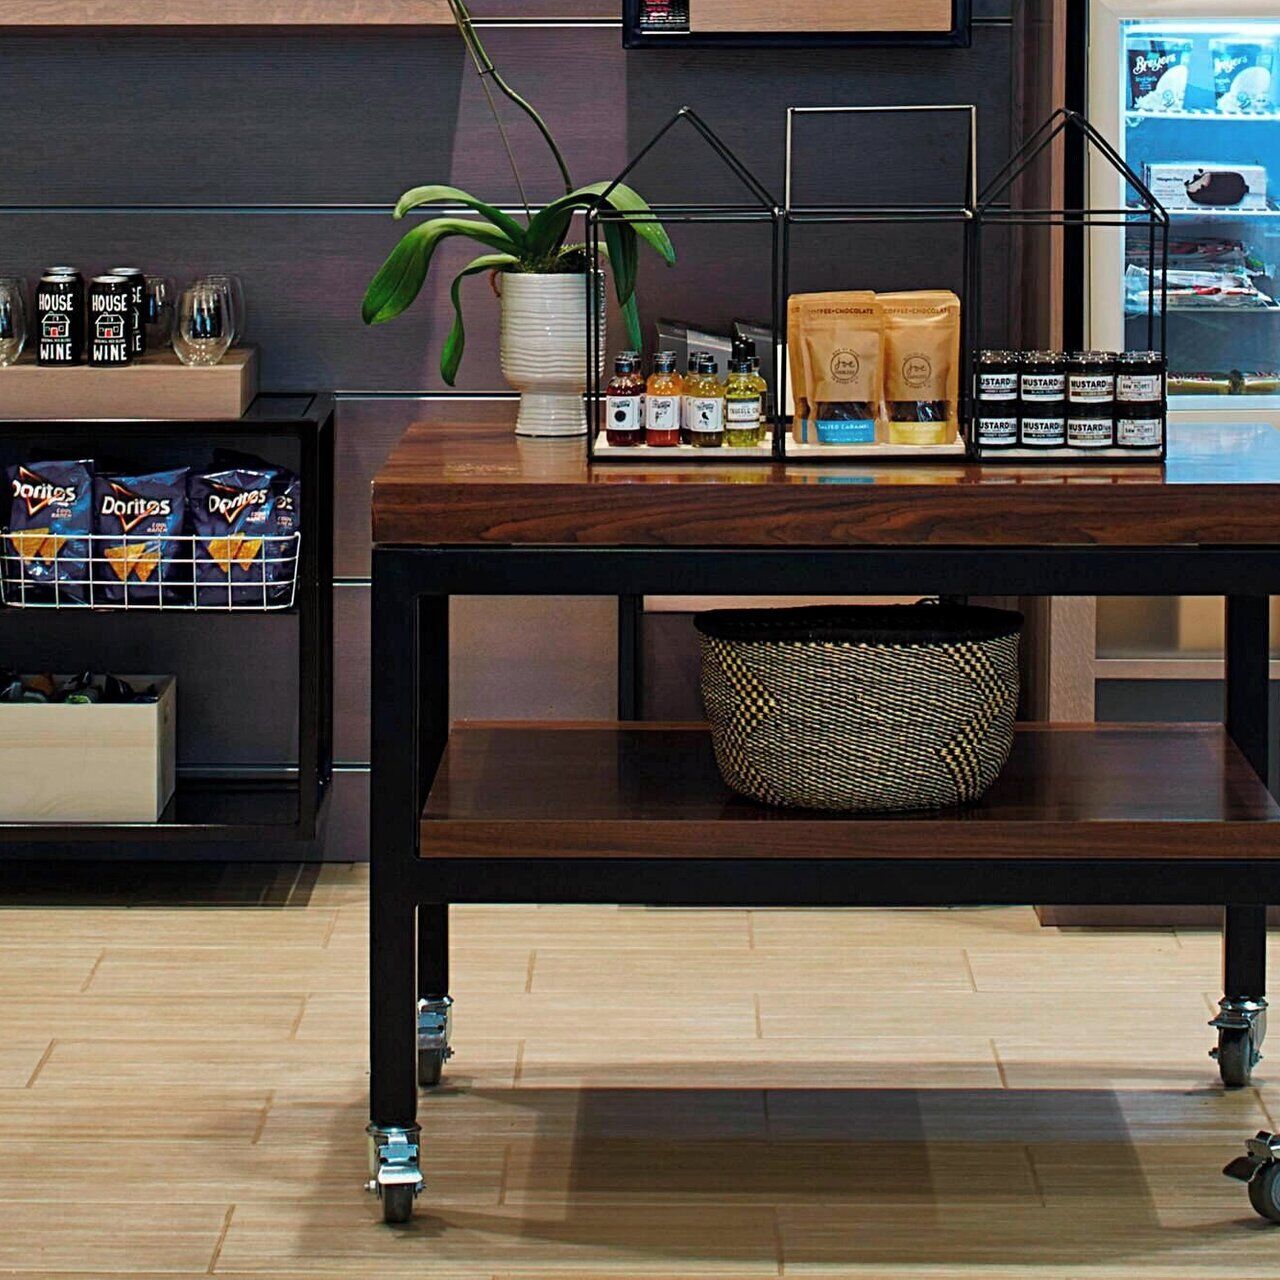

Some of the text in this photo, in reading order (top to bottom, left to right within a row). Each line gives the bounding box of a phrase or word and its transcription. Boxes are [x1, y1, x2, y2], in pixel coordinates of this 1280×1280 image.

[1133, 54, 1176, 74] Breyers
[38, 294, 73, 311] HOUSE
[92, 294, 127, 311] HOUSE
[40, 343, 72, 360] WINE
[93, 344, 127, 360] WINE
[980, 378, 1011, 386] USTARD
[1023, 378, 1059, 386] MUSTARD
[1071, 380, 1107, 388] MUSTARD
[979, 422, 1010, 430] USTARD
[102, 496, 170, 515] Doritos
[209, 489, 268, 512] Doritos
